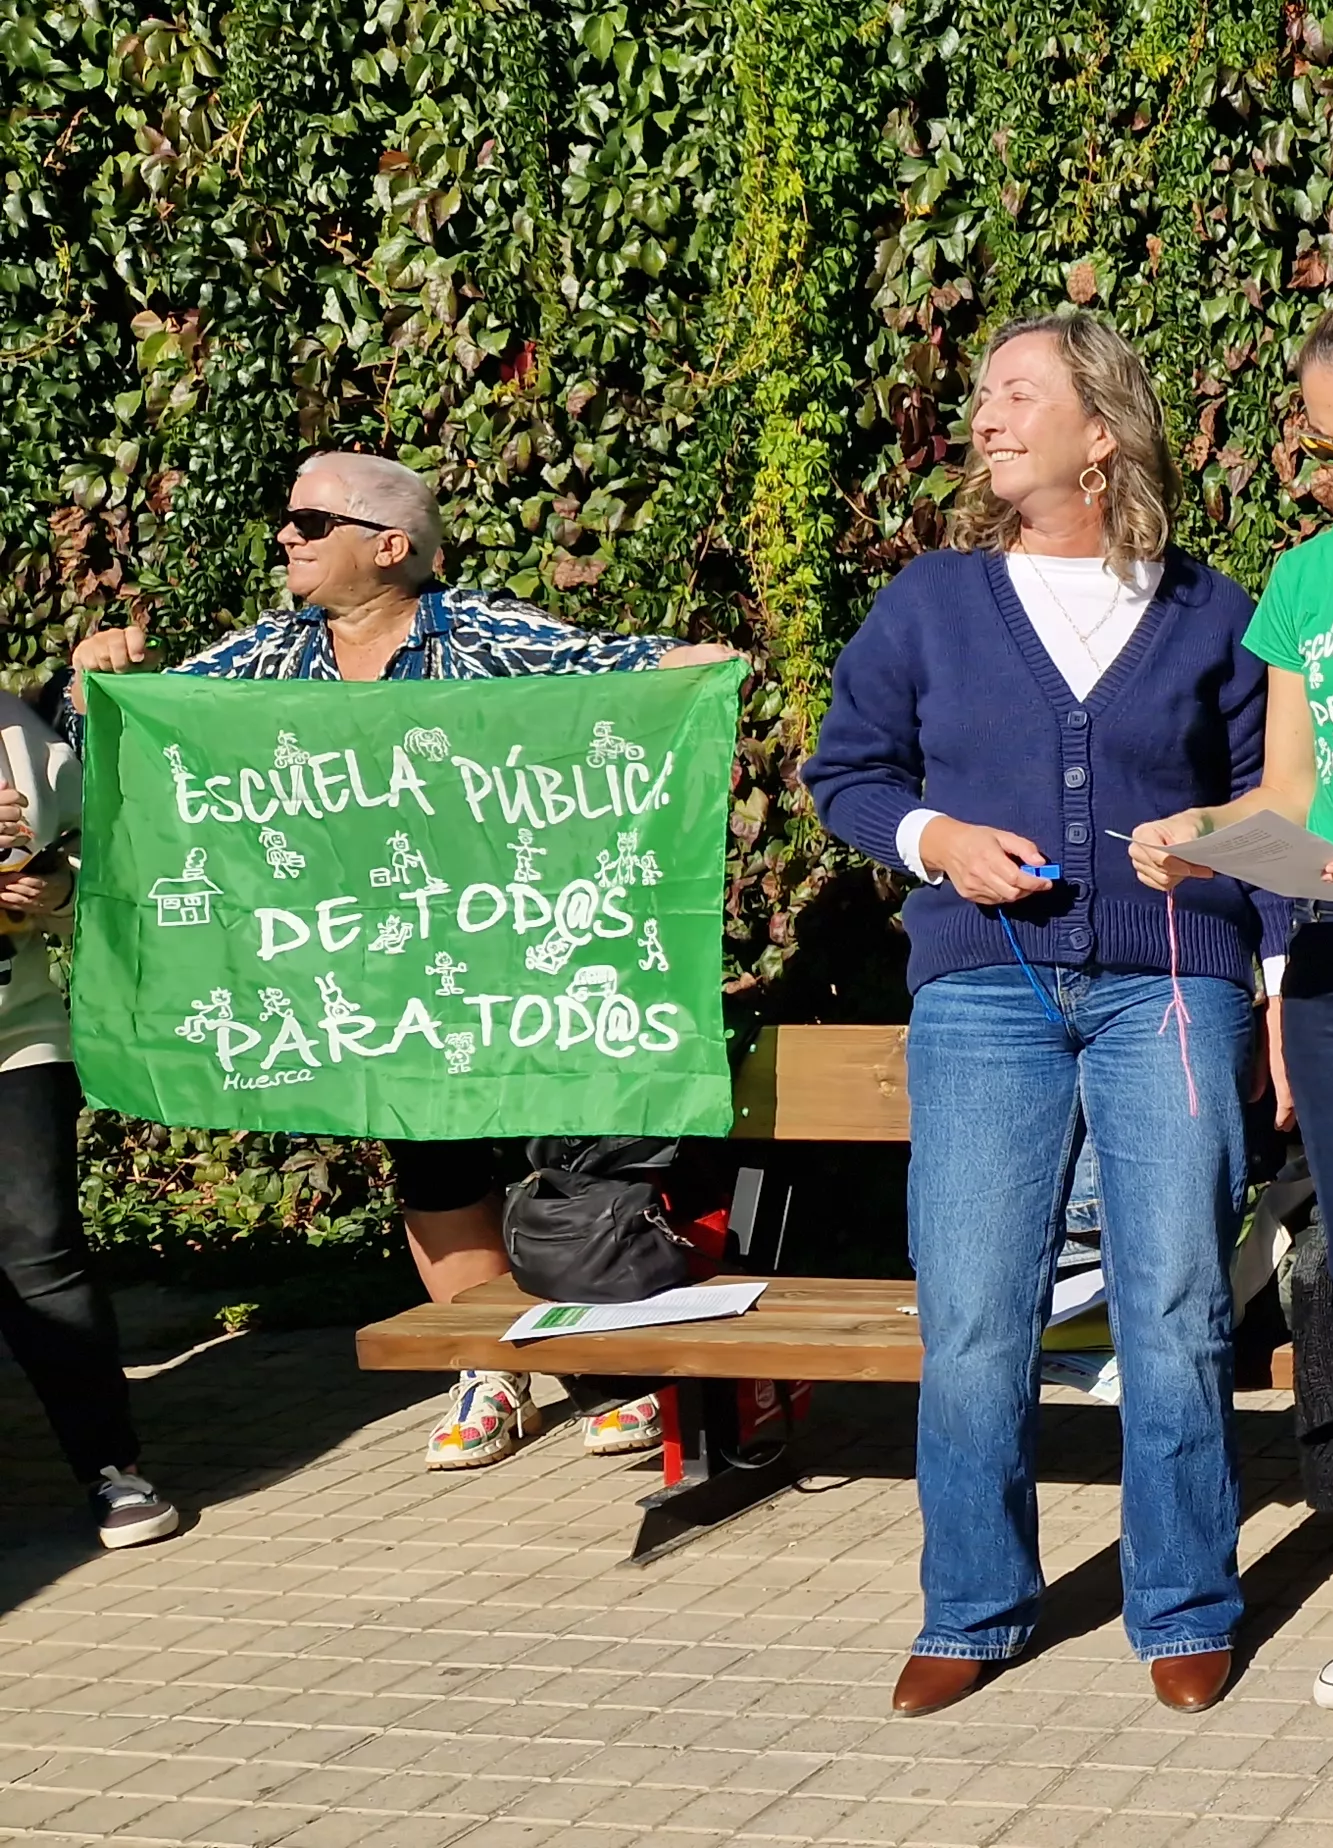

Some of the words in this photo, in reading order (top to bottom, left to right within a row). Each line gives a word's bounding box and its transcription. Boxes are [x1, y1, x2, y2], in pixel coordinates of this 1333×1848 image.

[174, 746, 435, 824] ESCUELA
[255, 896, 363, 961] DE
[399, 879, 635, 946] TOD@S
[208, 996, 443, 1073] PARA
[464, 994, 679, 1058] TOD@S
[223, 1067, 316, 1091] Huesca
